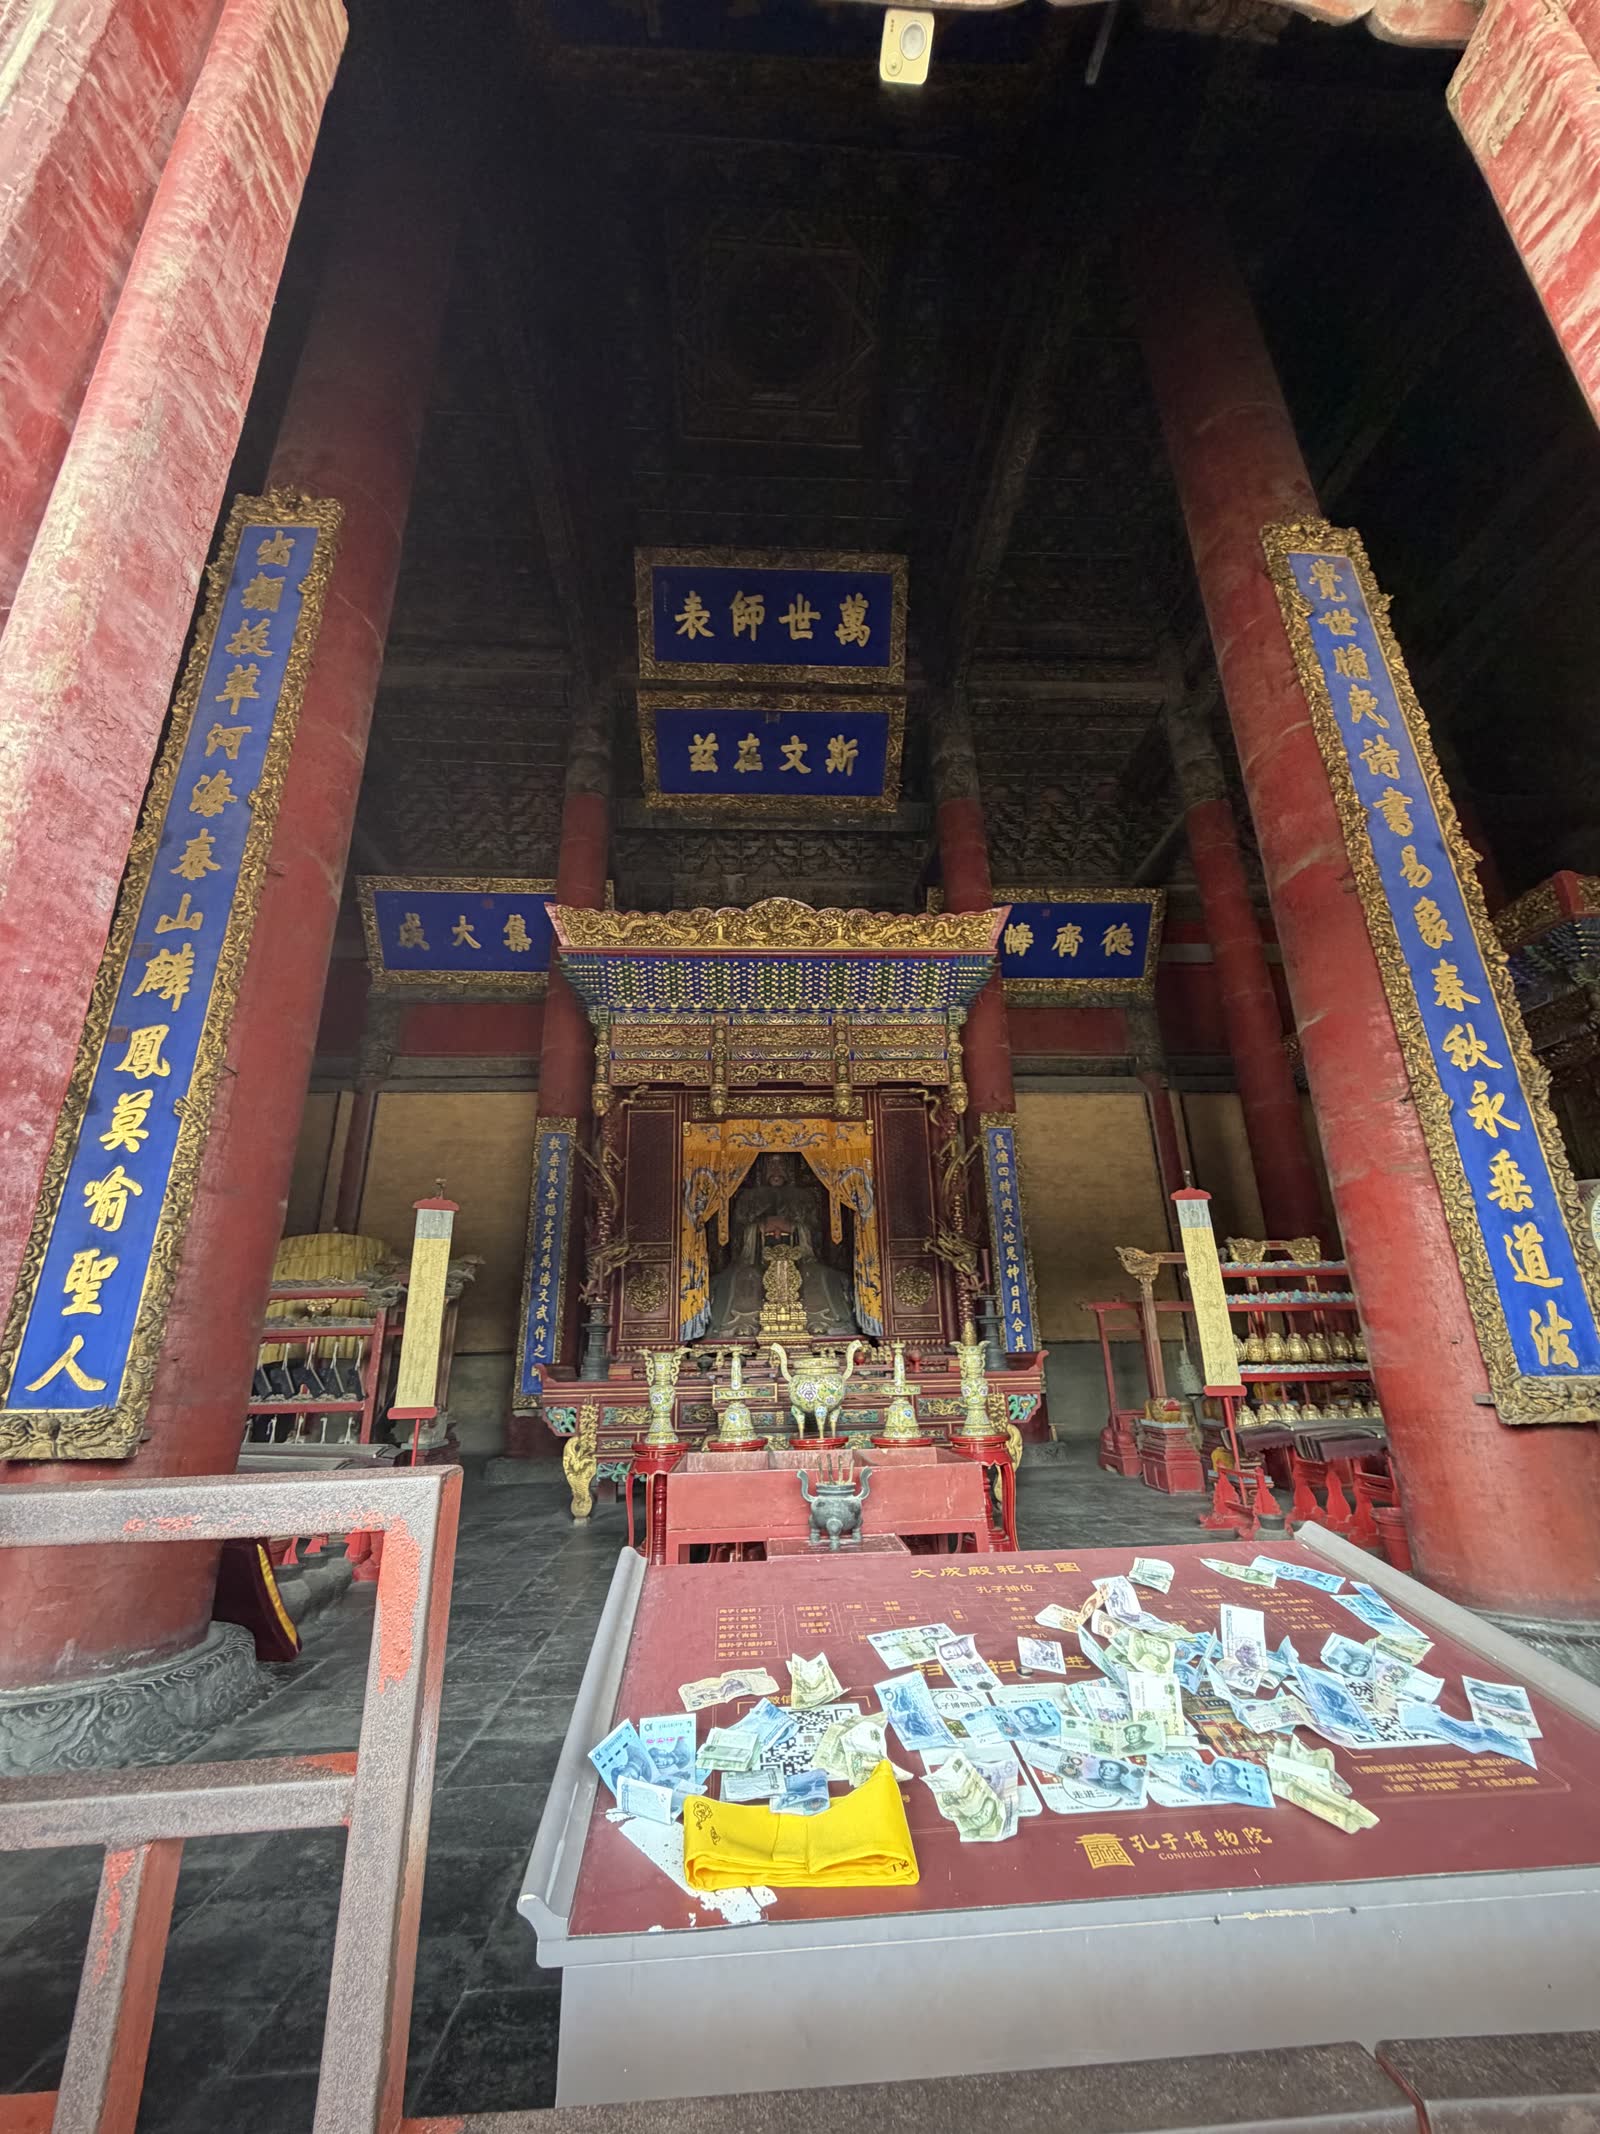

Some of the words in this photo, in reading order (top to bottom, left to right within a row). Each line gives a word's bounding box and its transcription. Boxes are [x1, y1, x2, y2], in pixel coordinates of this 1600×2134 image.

[1128, 1826, 1273, 1854] 孔子博物院
